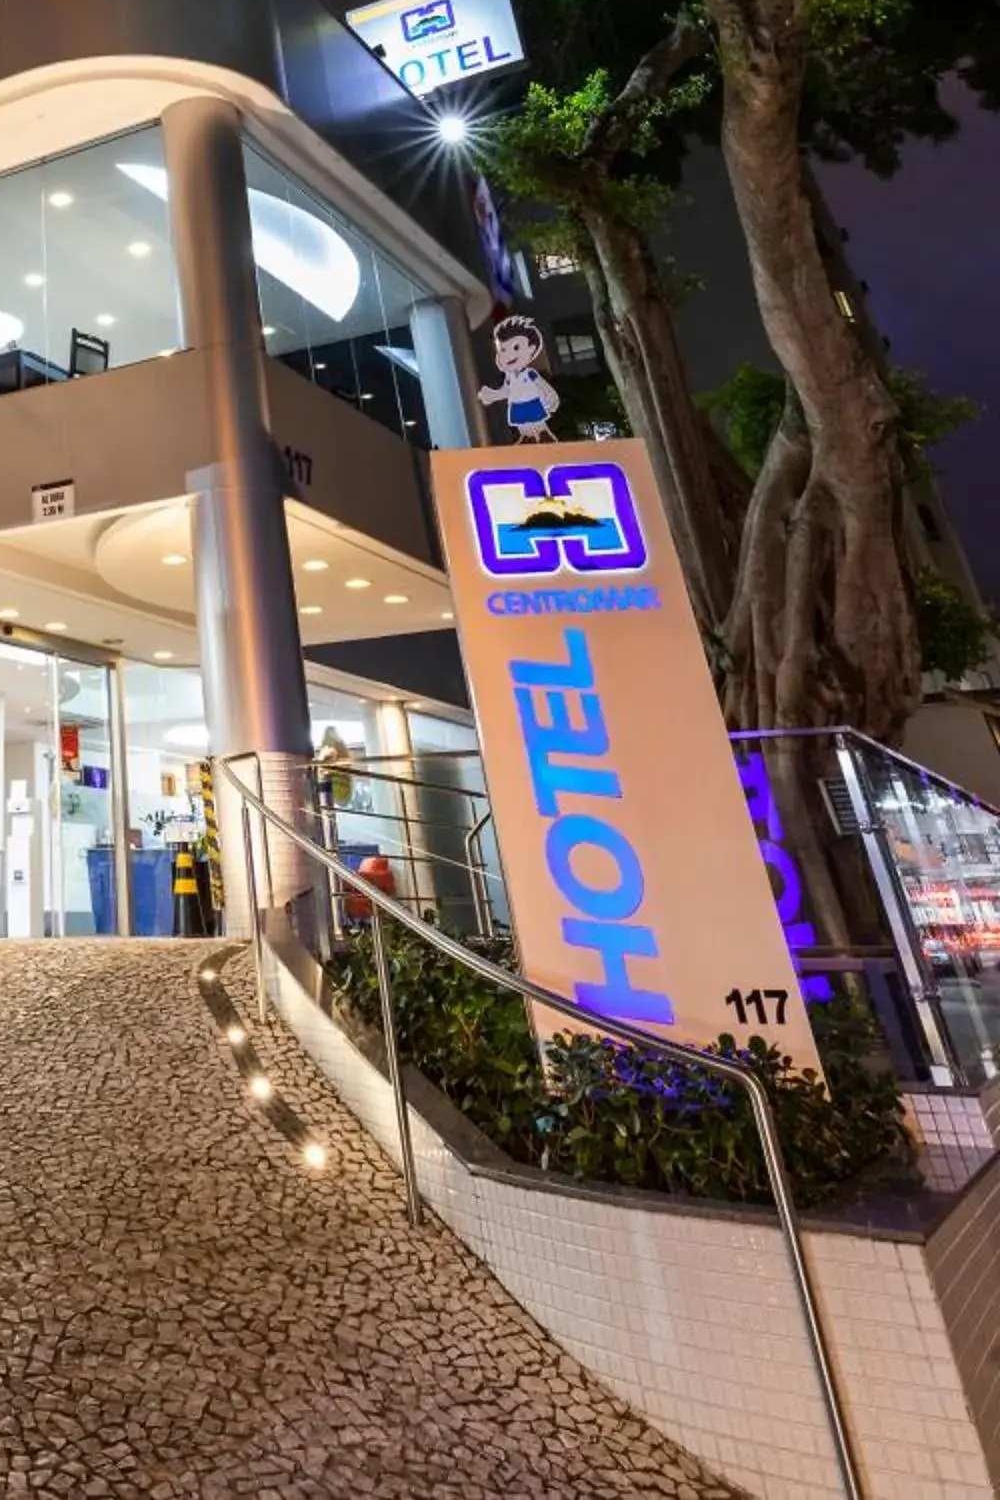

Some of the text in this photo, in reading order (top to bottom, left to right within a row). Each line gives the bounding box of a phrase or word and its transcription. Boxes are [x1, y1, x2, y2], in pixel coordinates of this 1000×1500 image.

[398, 35, 512, 88] OTEL
[486, 586, 662, 616] CENTROMAR
[508, 627, 674, 1025] HOTEL
[725, 987, 789, 1025] 117
